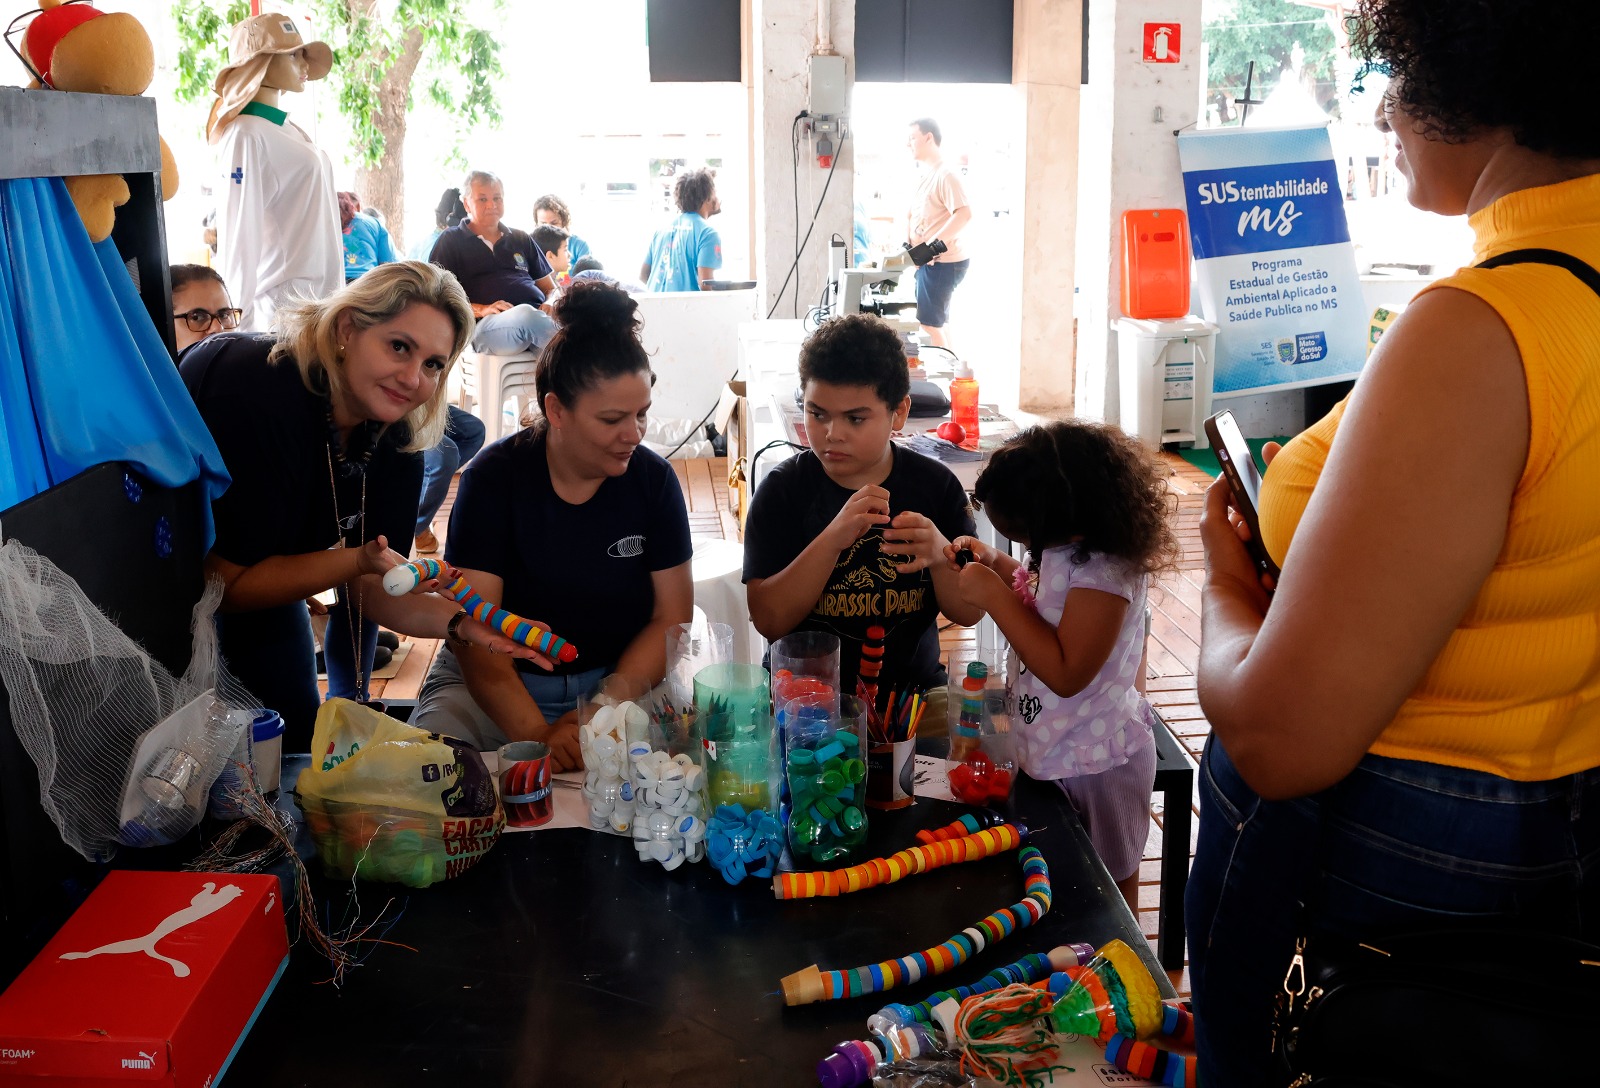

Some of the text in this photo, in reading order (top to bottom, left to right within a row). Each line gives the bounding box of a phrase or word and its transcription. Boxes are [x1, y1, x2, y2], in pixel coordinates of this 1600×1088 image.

[1198, 177, 1329, 206] SUStentabilidade
[1251, 256, 1303, 273] Programa
[1229, 268, 1329, 291] Estadual de Gestão
[1225, 284, 1337, 307] Ambiental Aplicado a
[1228, 299, 1338, 323] Saúde Publica no MS
[1260, 341, 1273, 350] SES
[1299, 339, 1316, 348] Mato
[1299, 345, 1323, 354] Grosso
[1300, 351, 1321, 361] do Sul
[815, 587, 926, 618] URASSIC PARK
[444, 833, 497, 856] CART
[0, 1048, 36, 1059] FOAM+
[121, 1058, 151, 1070] PUMA
